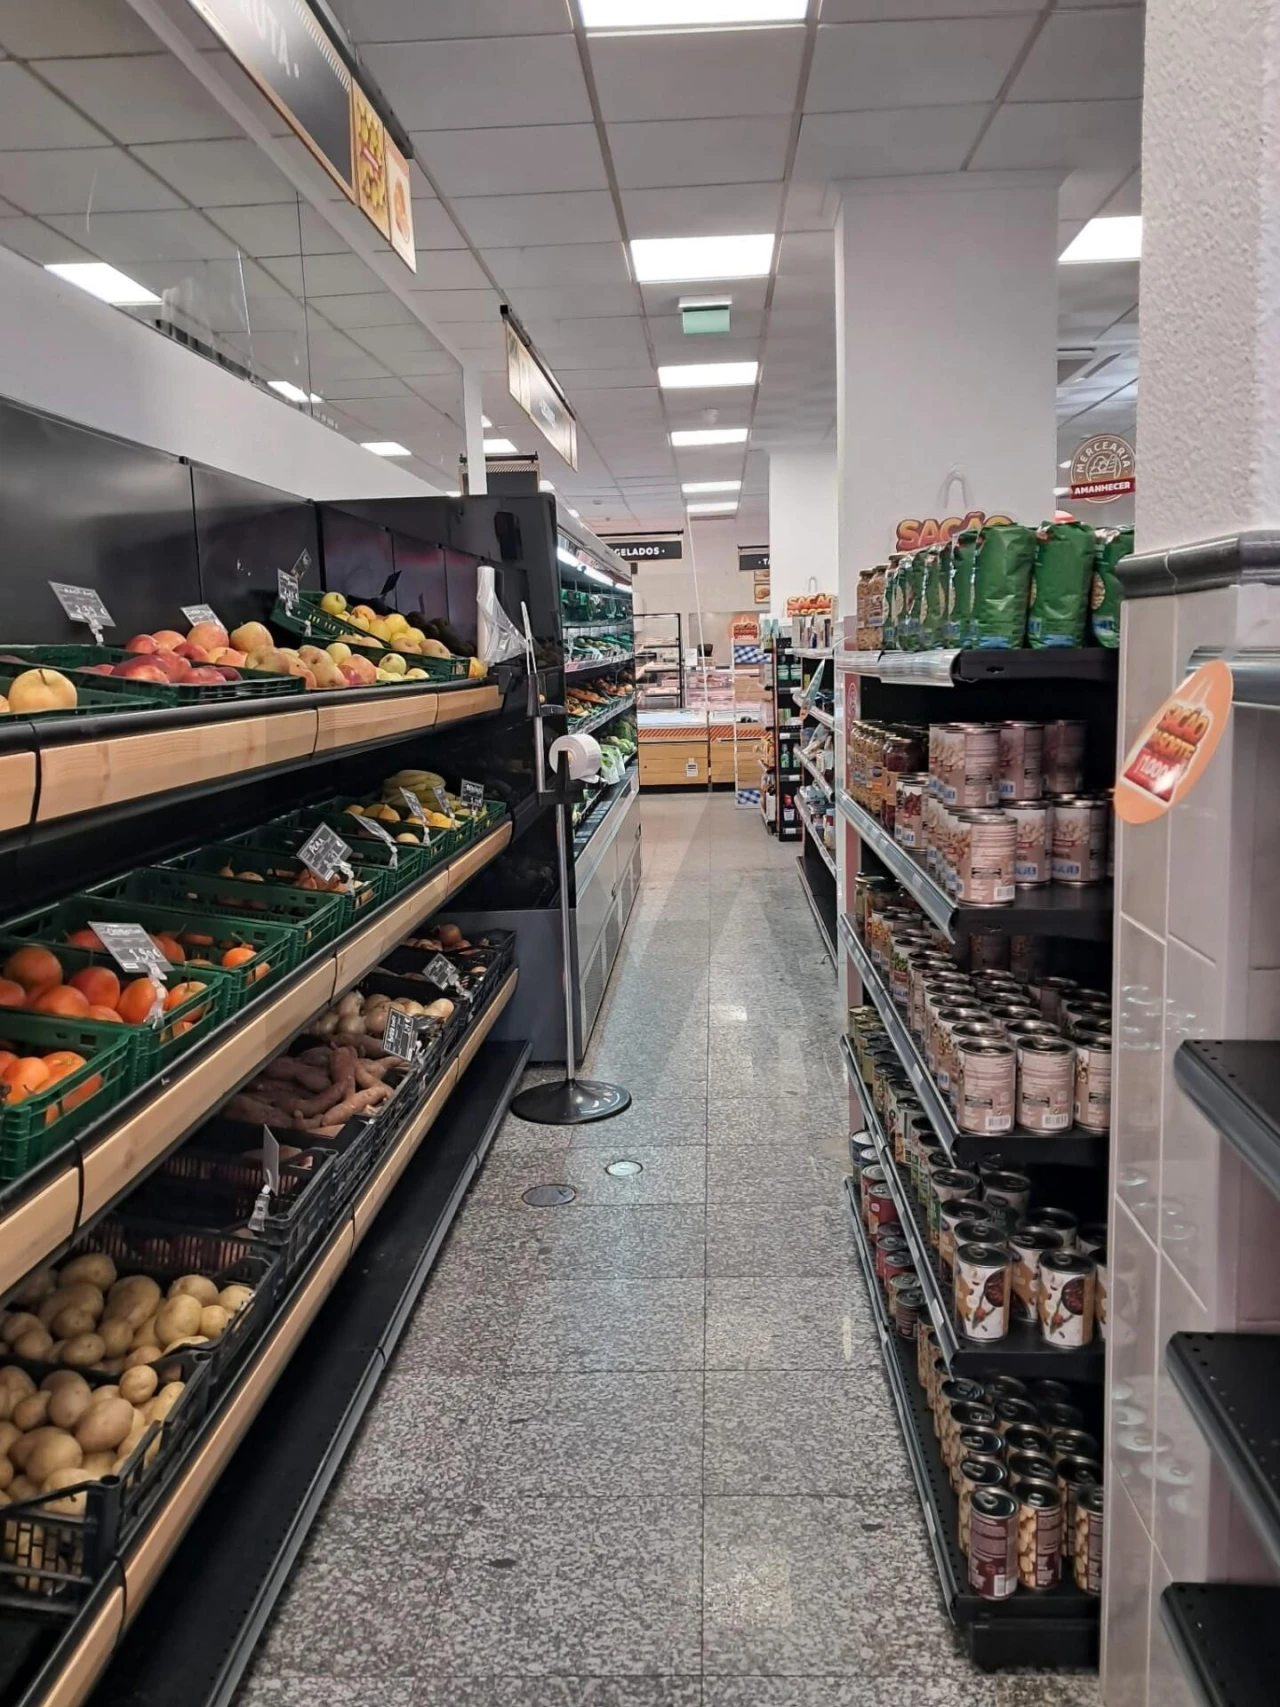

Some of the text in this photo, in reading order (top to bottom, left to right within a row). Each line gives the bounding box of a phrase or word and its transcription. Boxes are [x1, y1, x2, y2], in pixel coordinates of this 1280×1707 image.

[1076, 441, 1131, 473] MERCEARIA
[1074, 481, 1131, 495] AMANHECER
[611, 546, 660, 557] GELADOS
